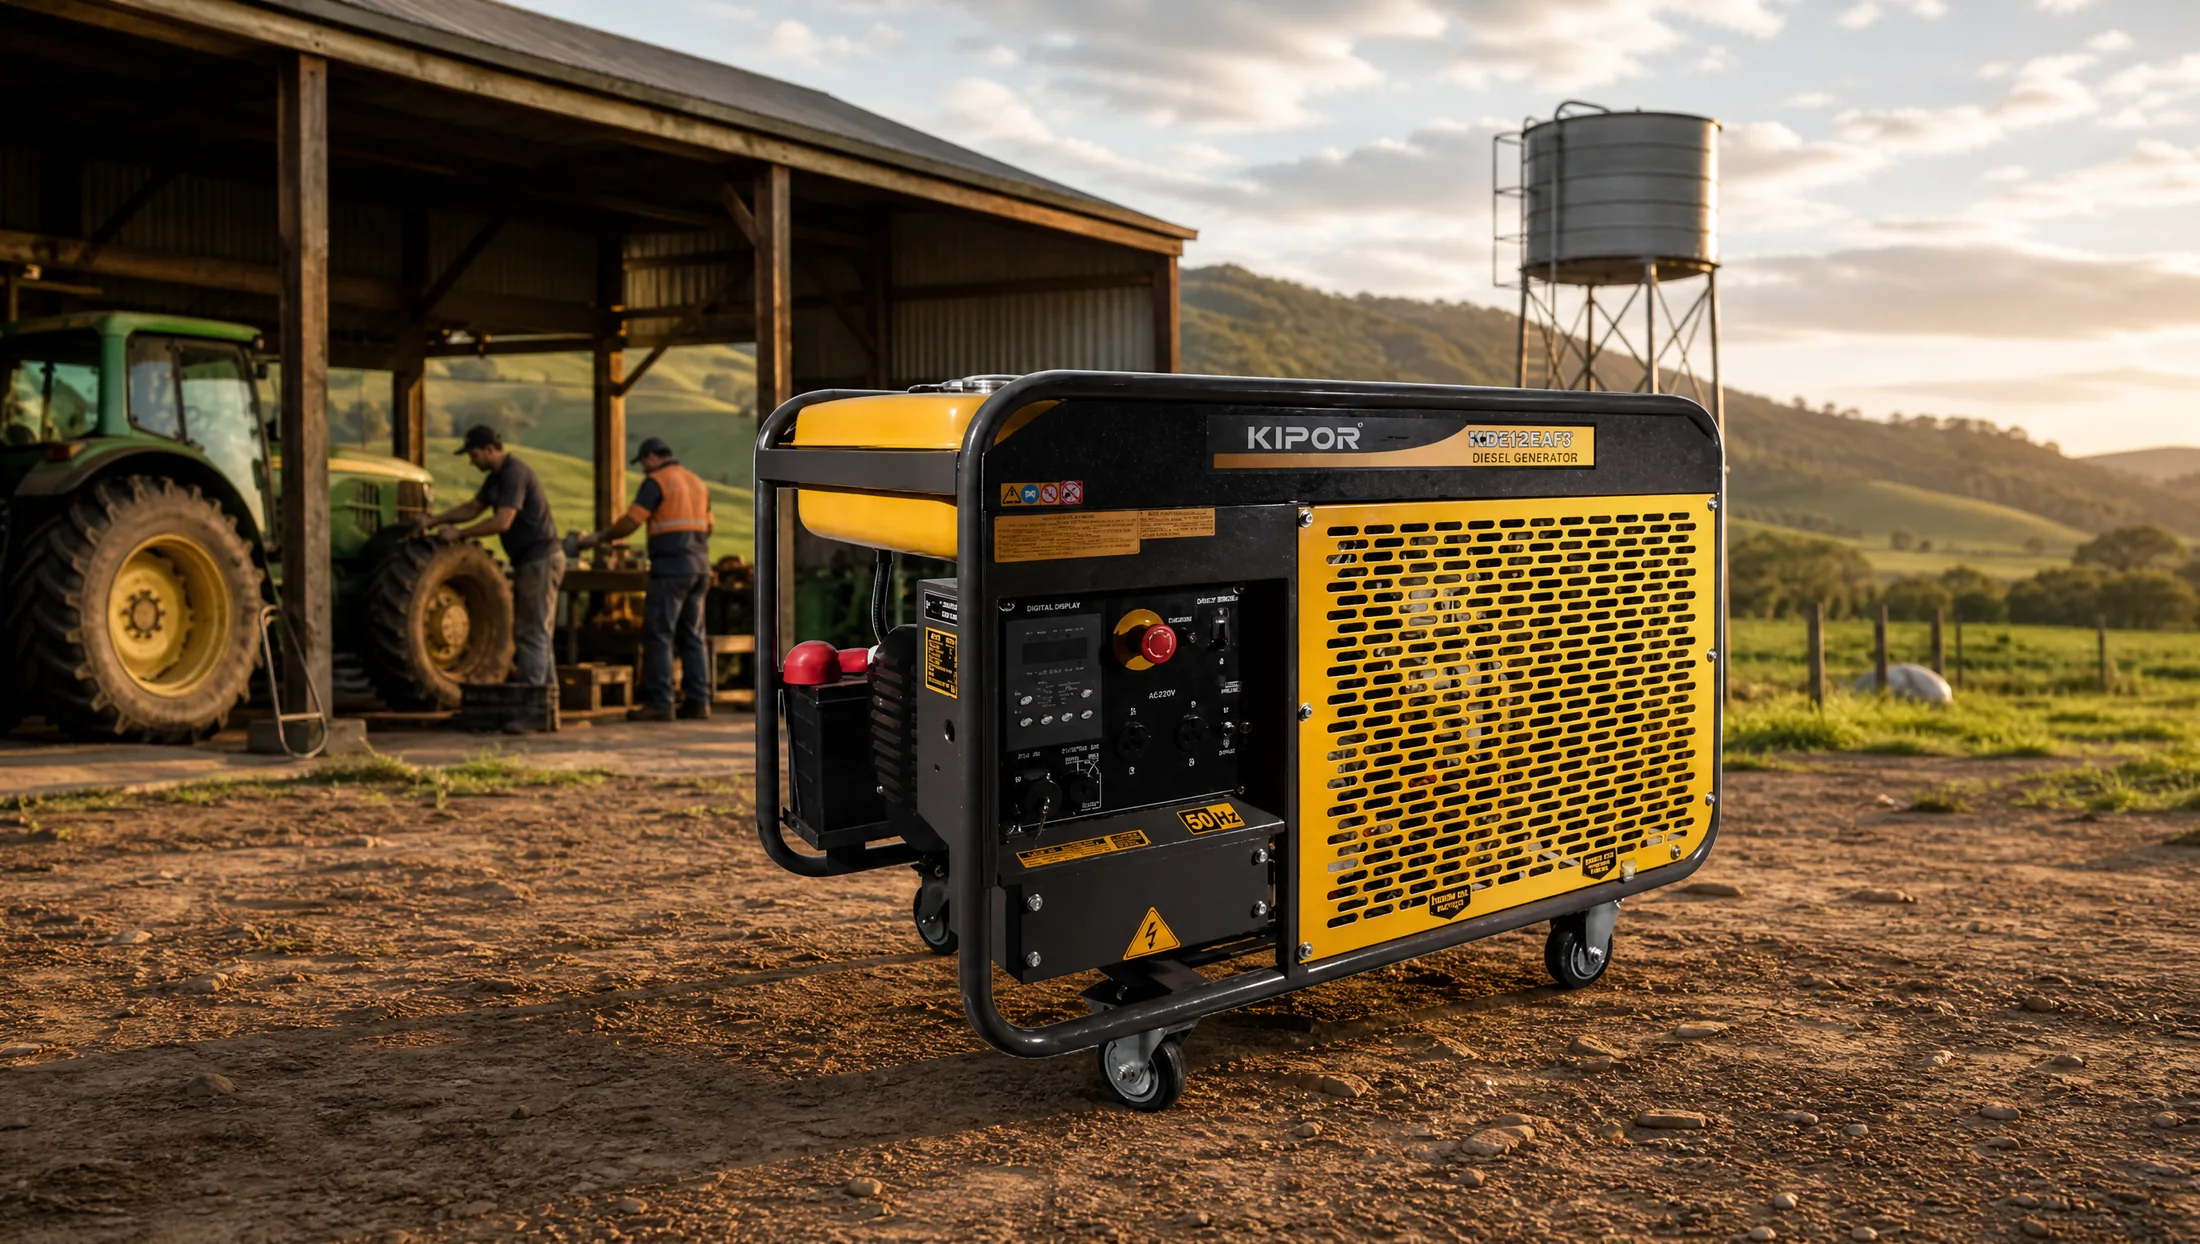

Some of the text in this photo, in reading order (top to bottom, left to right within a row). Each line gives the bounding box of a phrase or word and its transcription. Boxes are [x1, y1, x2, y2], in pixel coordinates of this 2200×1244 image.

[1247, 426, 1361, 450] KIPOR
[1472, 452, 1578, 463] DIESEL GENERATOR
[1026, 602, 1081, 612] DIGITAL DISPLAY
